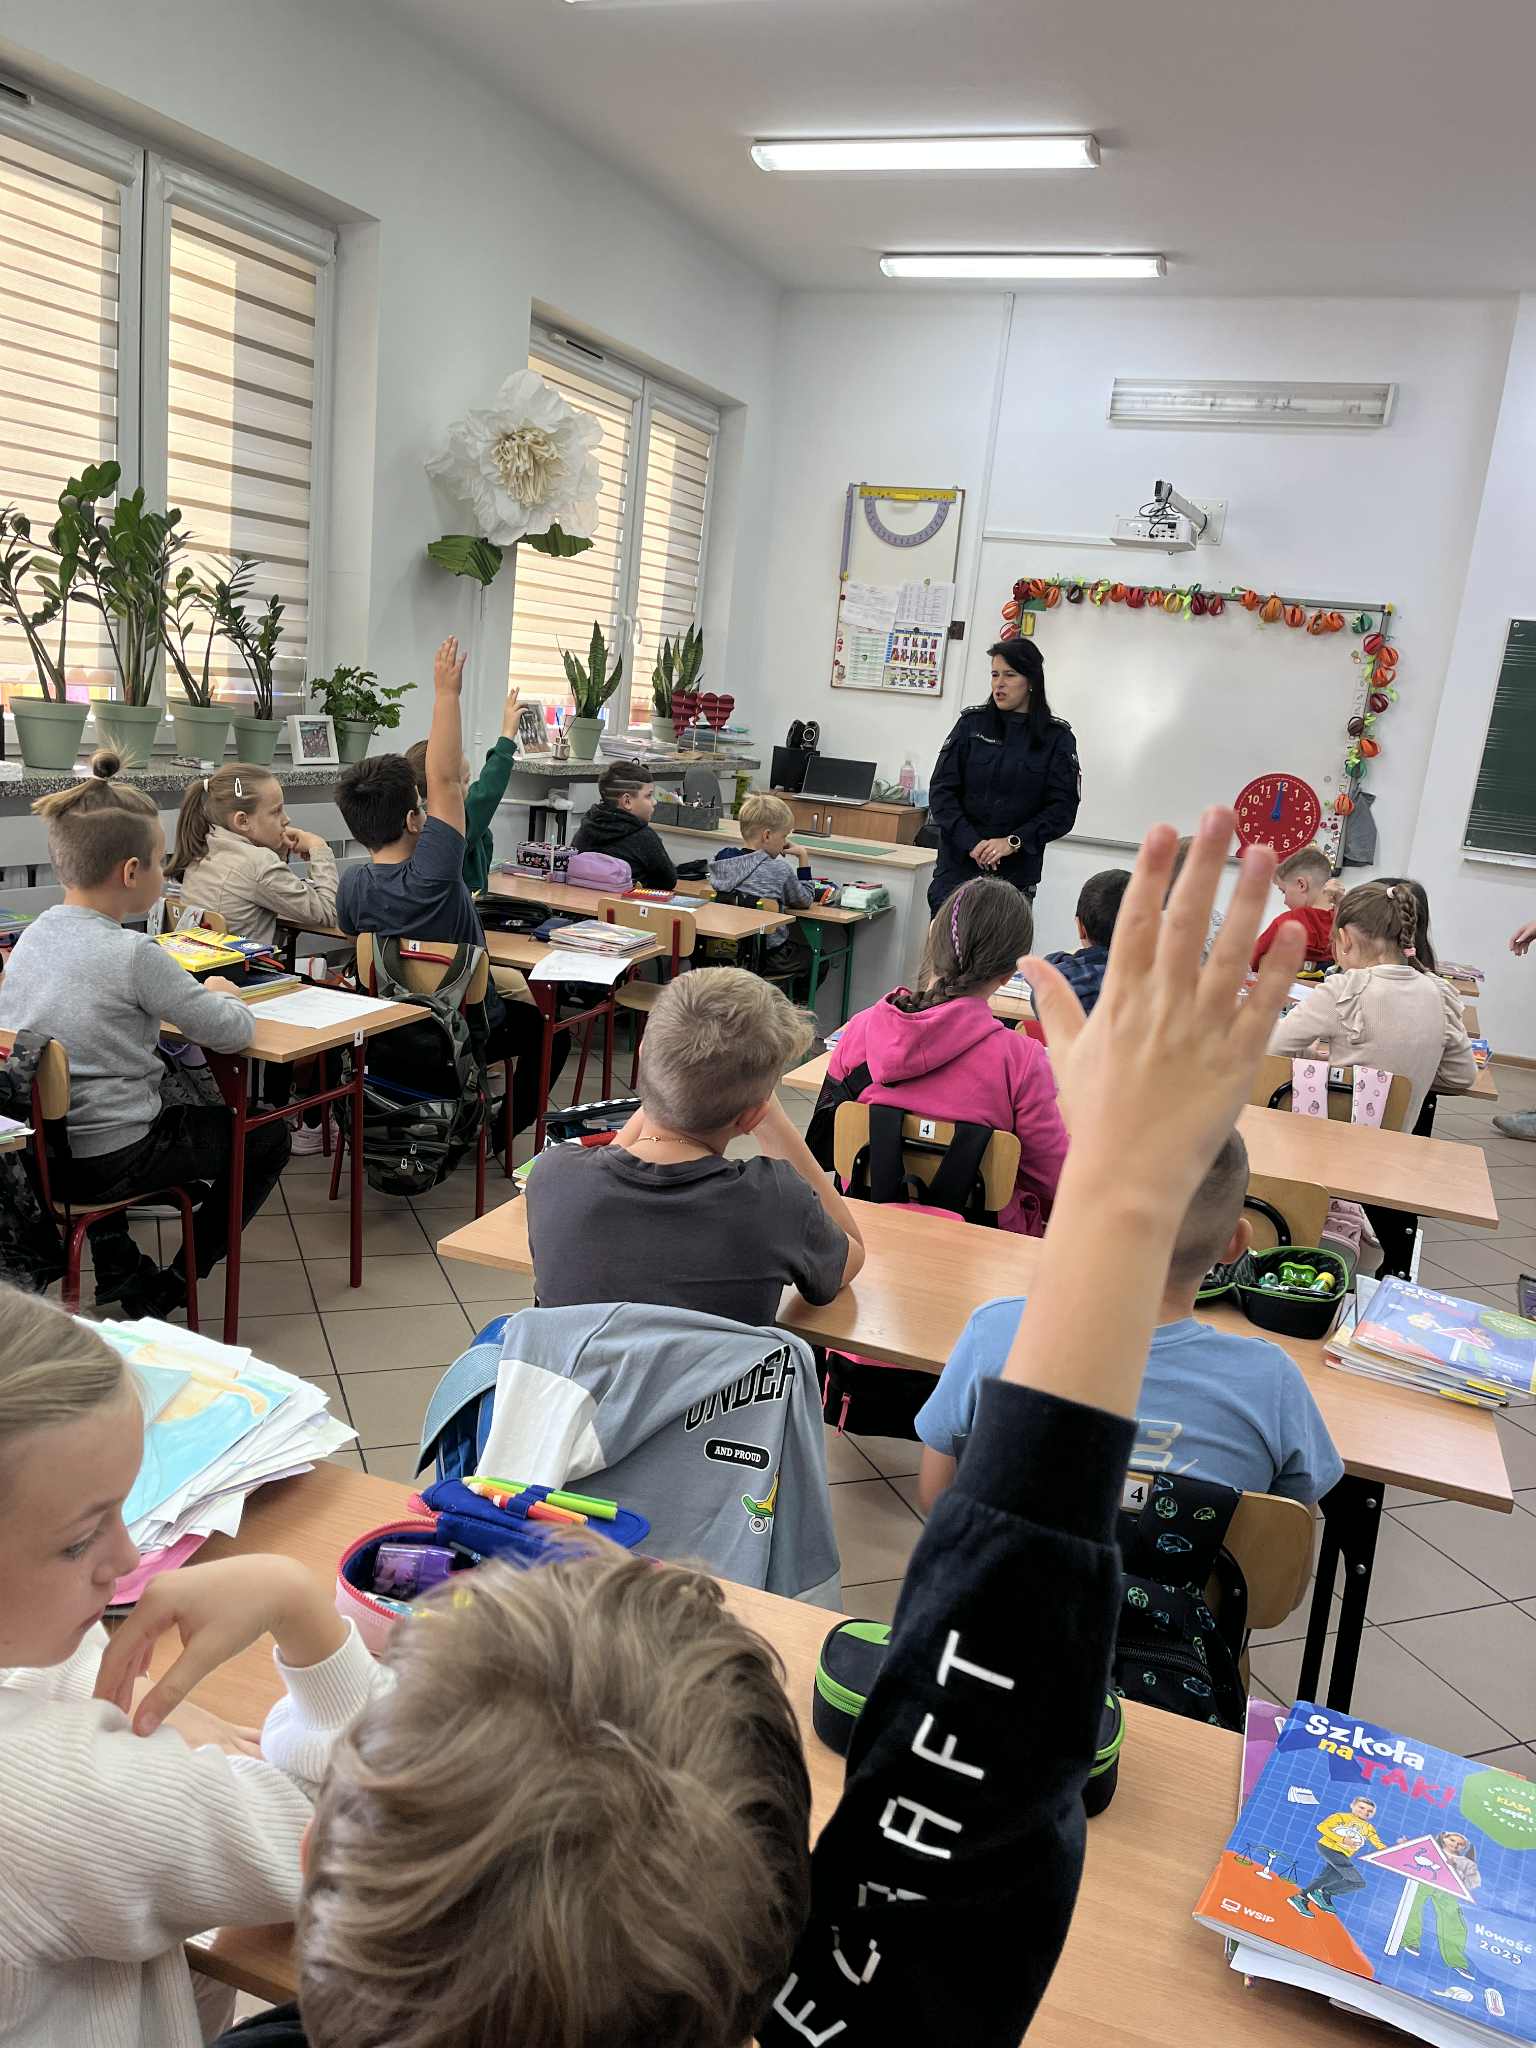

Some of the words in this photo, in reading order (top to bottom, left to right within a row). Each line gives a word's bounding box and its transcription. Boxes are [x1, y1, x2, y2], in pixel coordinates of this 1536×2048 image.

[1260, 785, 1271, 795] 11
[1294, 789, 1300, 799] 1
[1247, 794, 1260, 805] 10
[1303, 801, 1311, 811] 2
[1241, 807, 1248, 817] 9
[1305, 815, 1312, 825] 3
[1243, 822, 1251, 833] 8
[1254, 834, 1261, 844] 7
[1296, 830, 1304, 840] 4
[1282, 839, 1290, 849] 5
[922, 1124, 930, 1135] 4
[714, 1445, 733, 1457] AND
[734, 1449, 761, 1463] PROUD
[1130, 1486, 1144, 1503] 4
[1305, 1714, 1425, 1771] Szkoła
[1318, 1738, 1354, 1761] na
[1357, 1755, 1457, 1809] TAK!
[1475, 1923, 1533, 1954] Nowość
[1479, 1939, 1522, 1966] 2025
